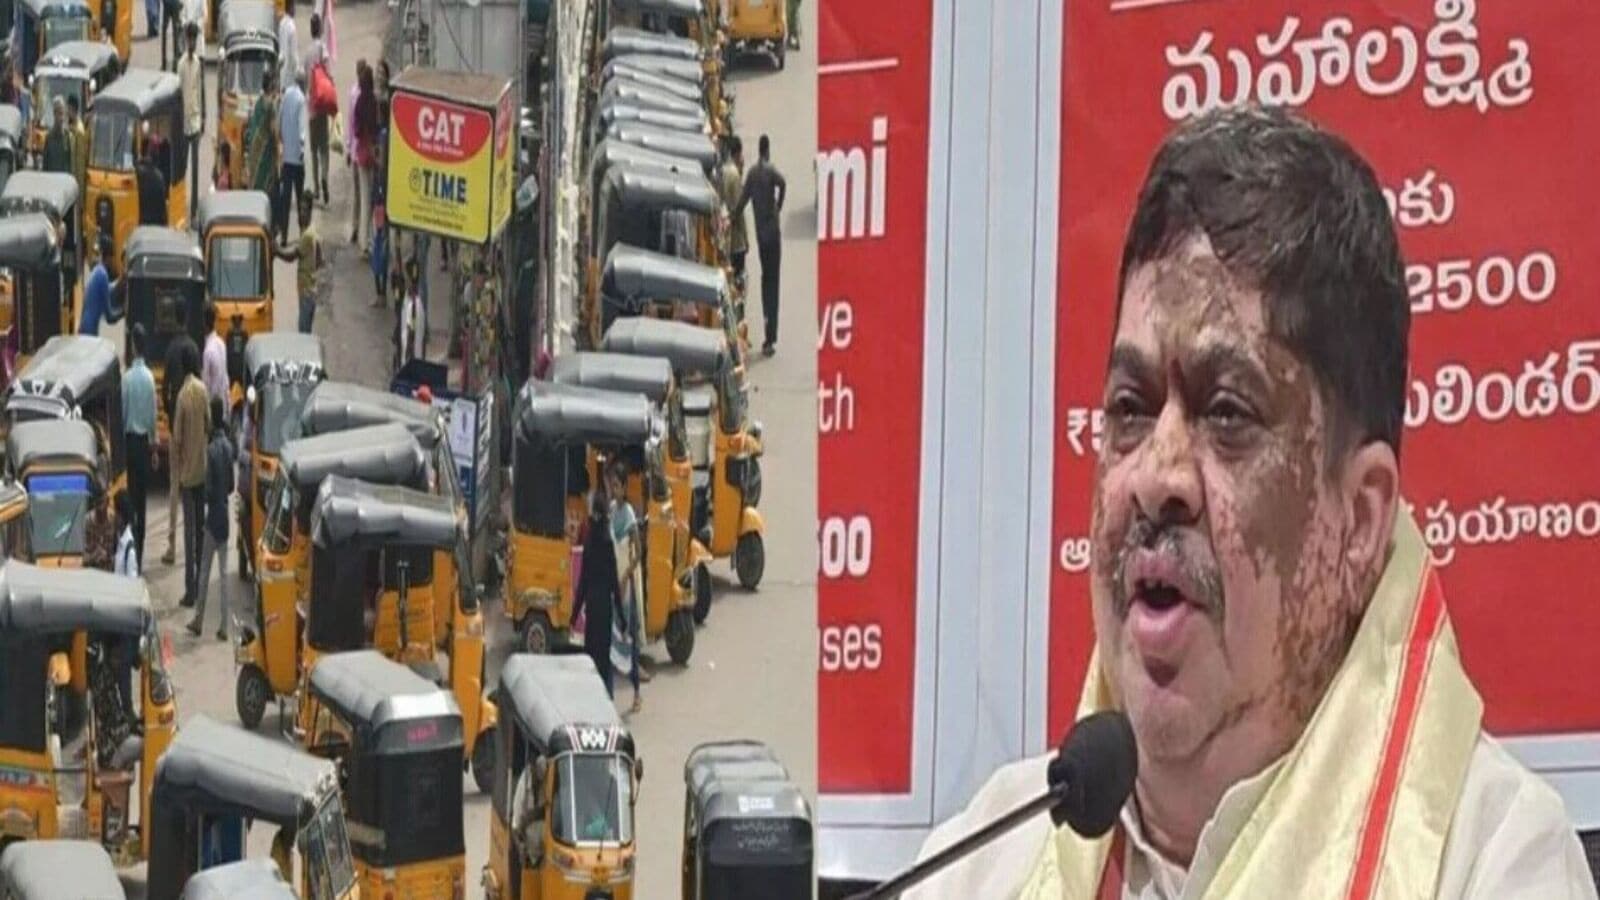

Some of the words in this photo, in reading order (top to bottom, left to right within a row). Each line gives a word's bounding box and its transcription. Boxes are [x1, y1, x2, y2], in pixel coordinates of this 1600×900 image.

[1161, 0, 1535, 119] మహాలక్ష్మి
[418, 107, 465, 147] CAT
[423, 169, 467, 204] TIME
[817, 515, 872, 577] 00
[817, 624, 882, 672] ses
